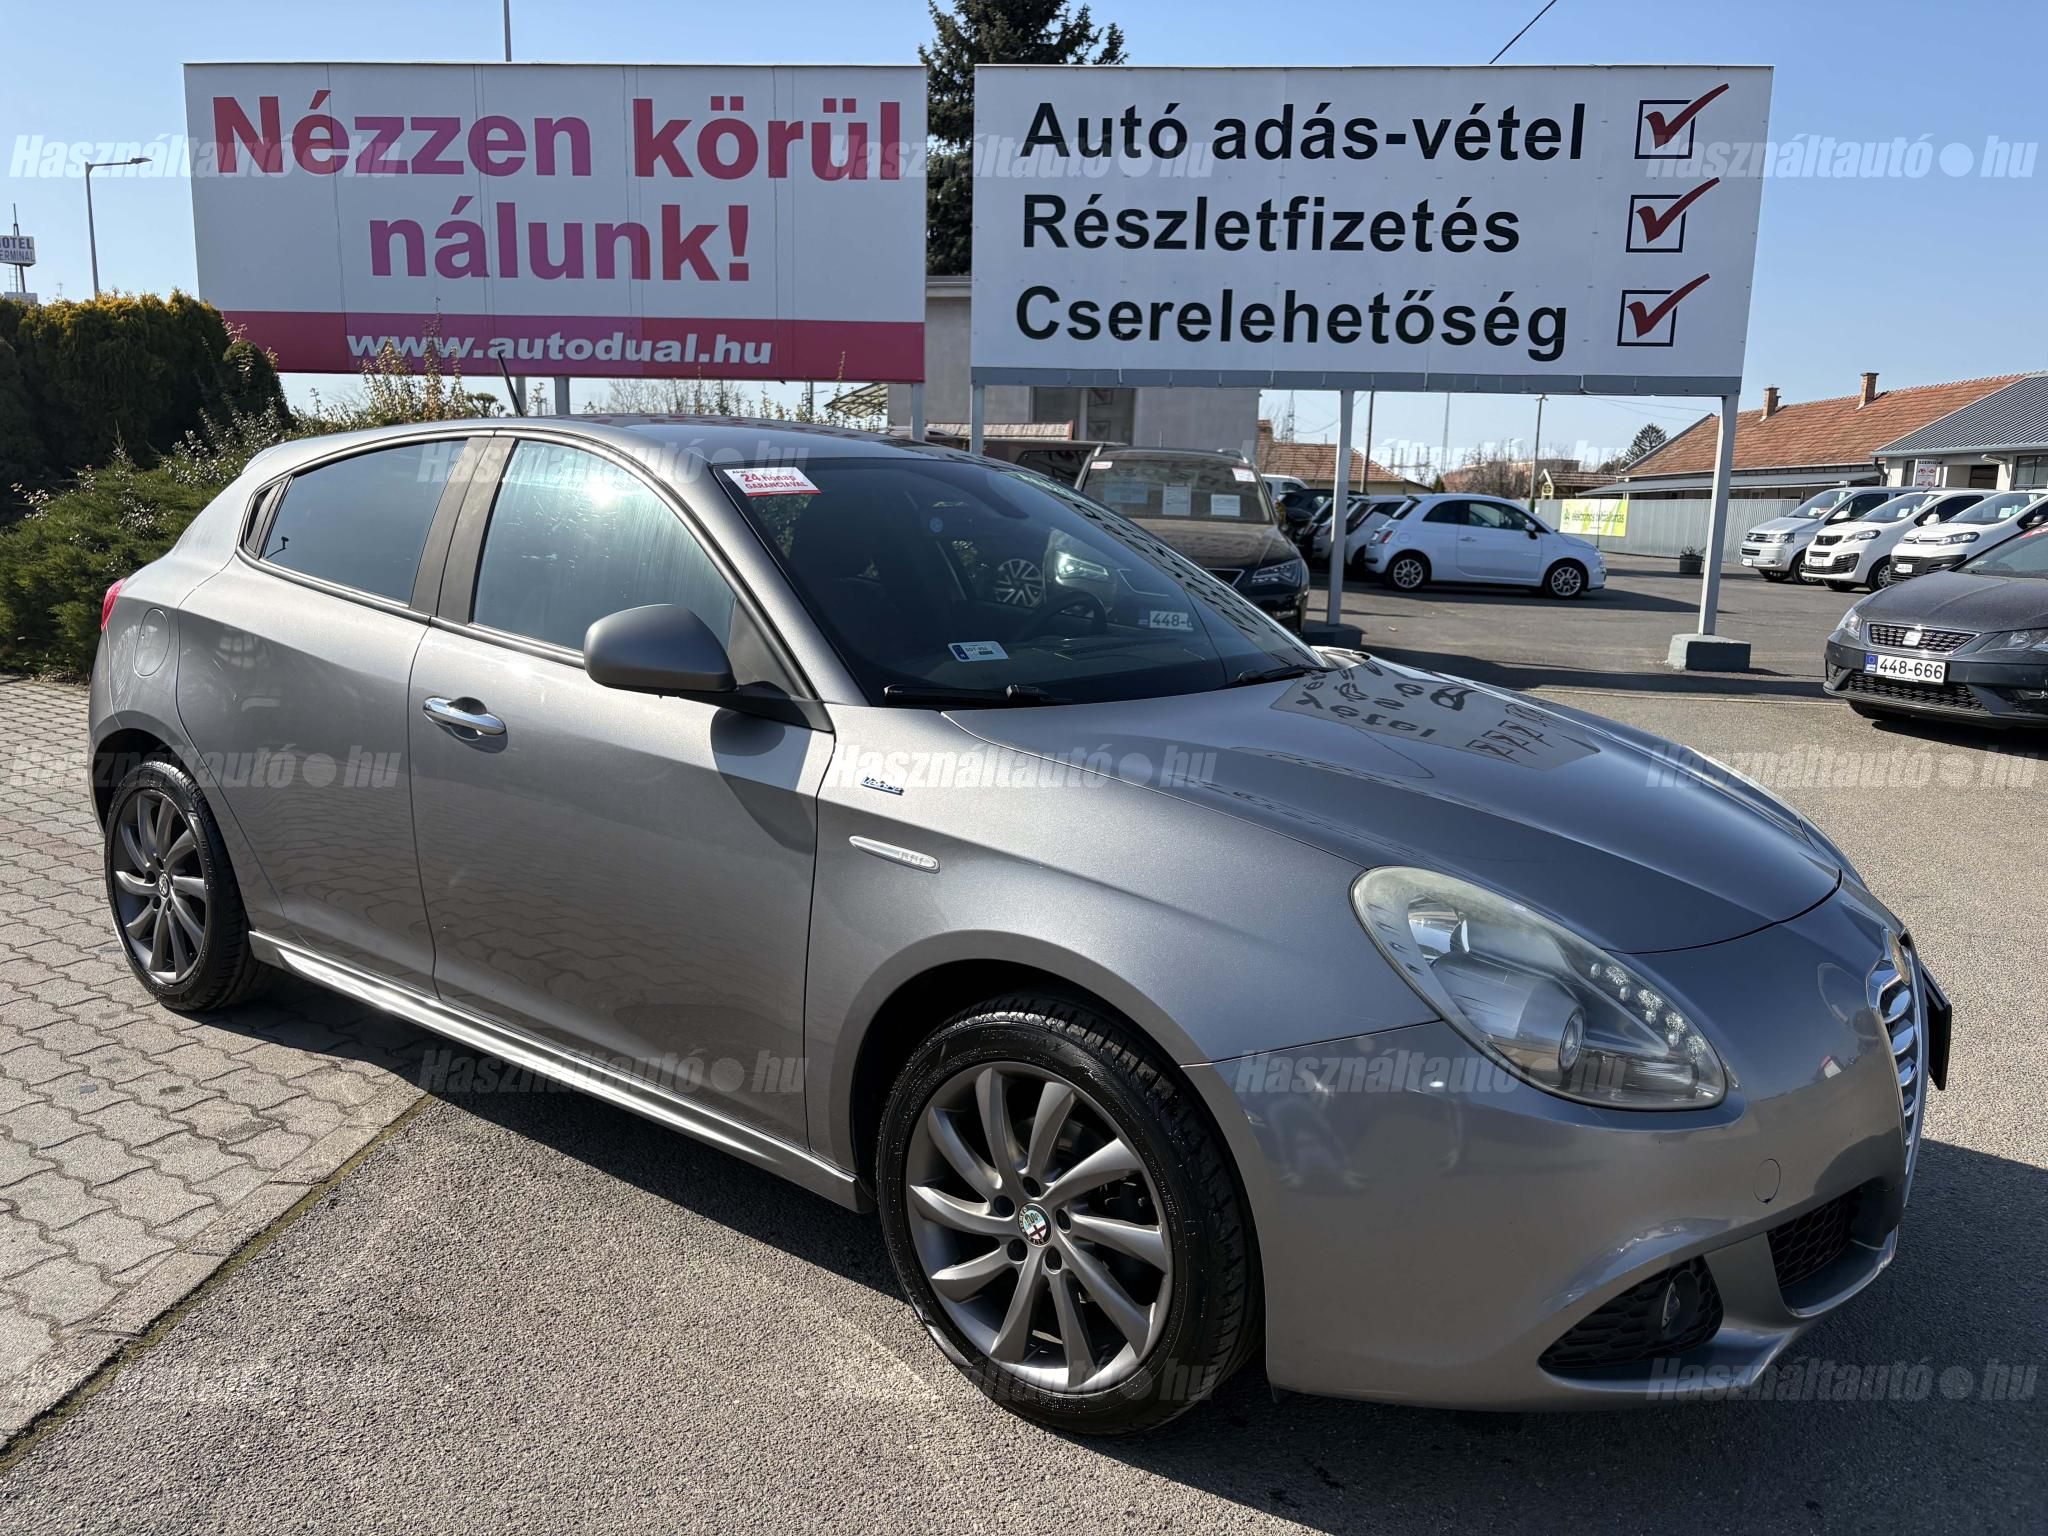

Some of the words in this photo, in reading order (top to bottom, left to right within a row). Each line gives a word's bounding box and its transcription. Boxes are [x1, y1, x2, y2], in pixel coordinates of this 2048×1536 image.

[213, 89, 592, 176] Nézzen
[633, 95, 901, 180] körül
[1020, 102, 1187, 160] Autó
[1212, 102, 1586, 161] adás-vétel
[370, 195, 749, 282] nálunk!
[1024, 192, 1520, 253] Részletfizetés
[0, 249, 34, 262] ERMINAL
[346, 331, 772, 364] www.autodual.hu
[1017, 286, 1568, 362] Cserelehetőség
[742, 474, 762, 483] 24
[761, 472, 797, 482] hónap
[1879, 658, 1944, 680] 448-666
